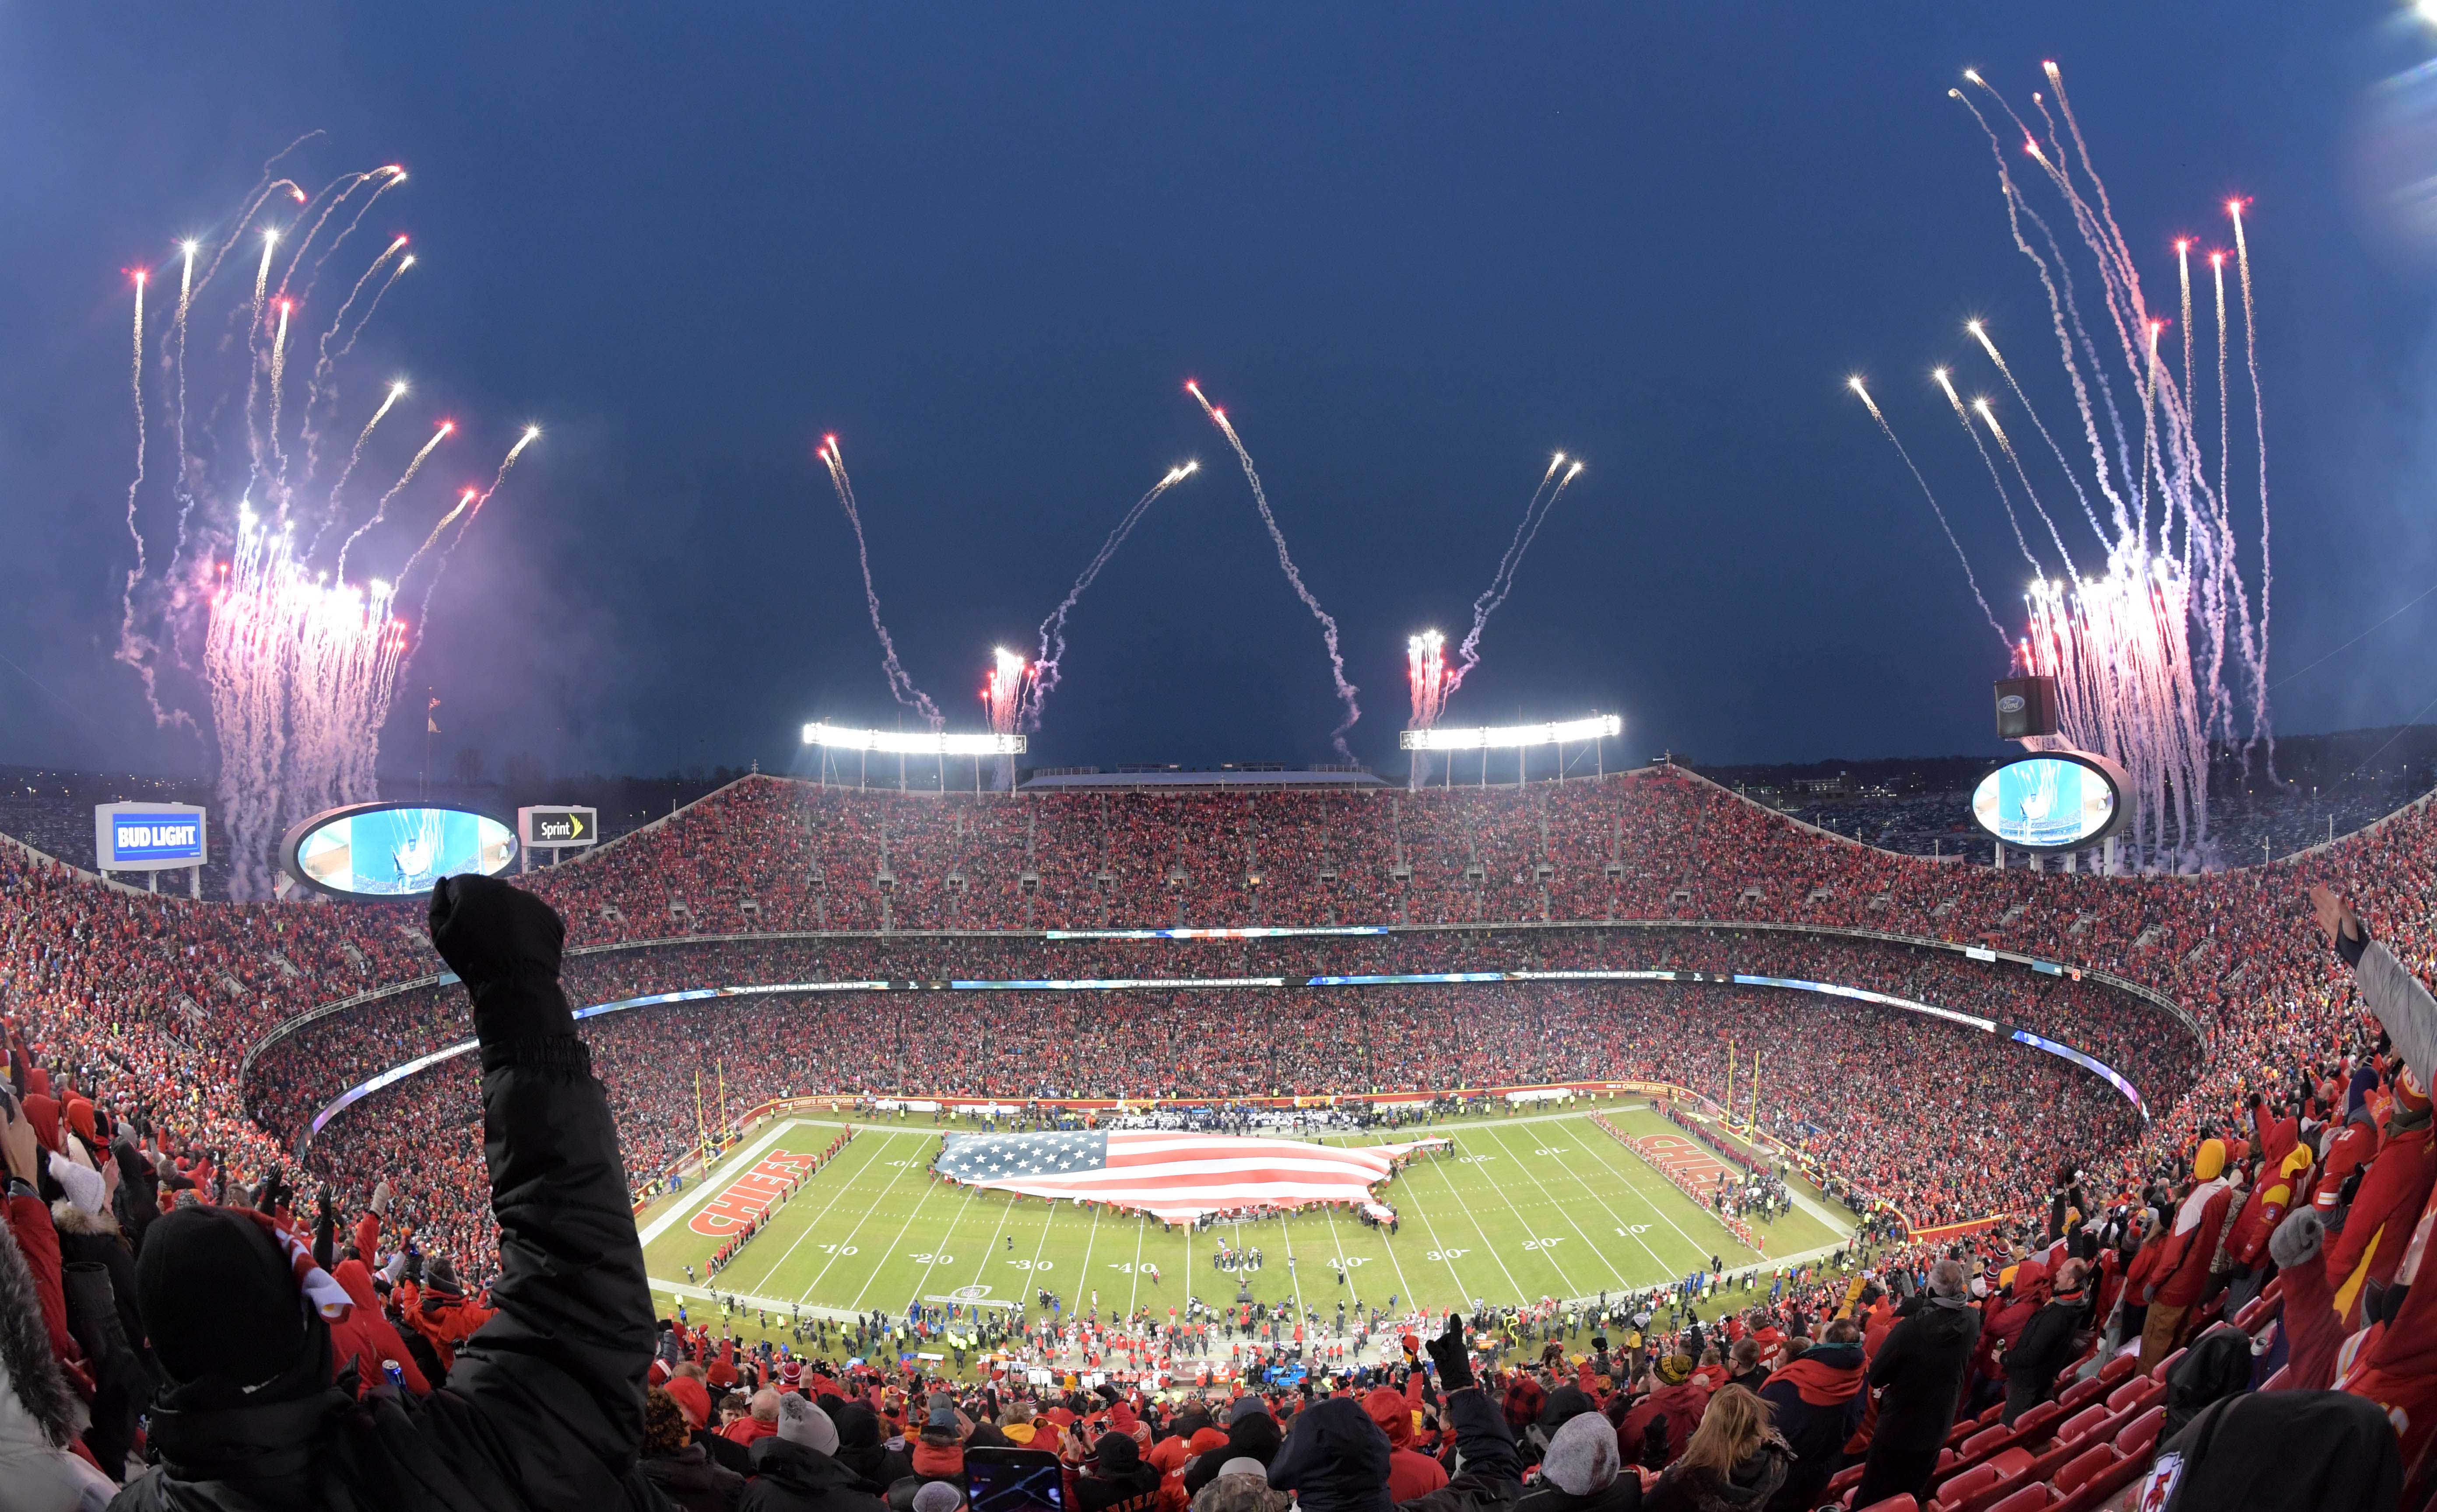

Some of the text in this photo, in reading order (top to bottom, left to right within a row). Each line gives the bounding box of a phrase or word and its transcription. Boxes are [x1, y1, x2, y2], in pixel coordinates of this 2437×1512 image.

[2003, 699, 2019, 709] Ford
[541, 821, 570, 839] Sprint
[118, 826, 194, 848] BUD LIGHT
[2073, 969, 2080, 979] 29
[2096, 975, 2123, 986] PRIEST HOLMES
[2131, 986, 2140, 994] GARY
[2141, 990, 2151, 999] GREEN
[1646, 1084, 1678, 1095] KINGDM
[688, 1149, 818, 1237] CHIEFS
[1615, 1225, 1646, 1237] 10
[824, 1244, 858, 1255] 10
[1522, 1238, 1556, 1250] 20
[916, 1253, 953, 1264] 20
[1426, 1249, 1461, 1261] 30
[1015, 1259, 1053, 1270] 30
[1118, 1263, 1156, 1273] 40
[1326, 1257, 1362, 1268] 40
[928, 1296, 1007, 1305] CHAMPIONSHIP
[1764, 1343, 1778, 1355] JONES
